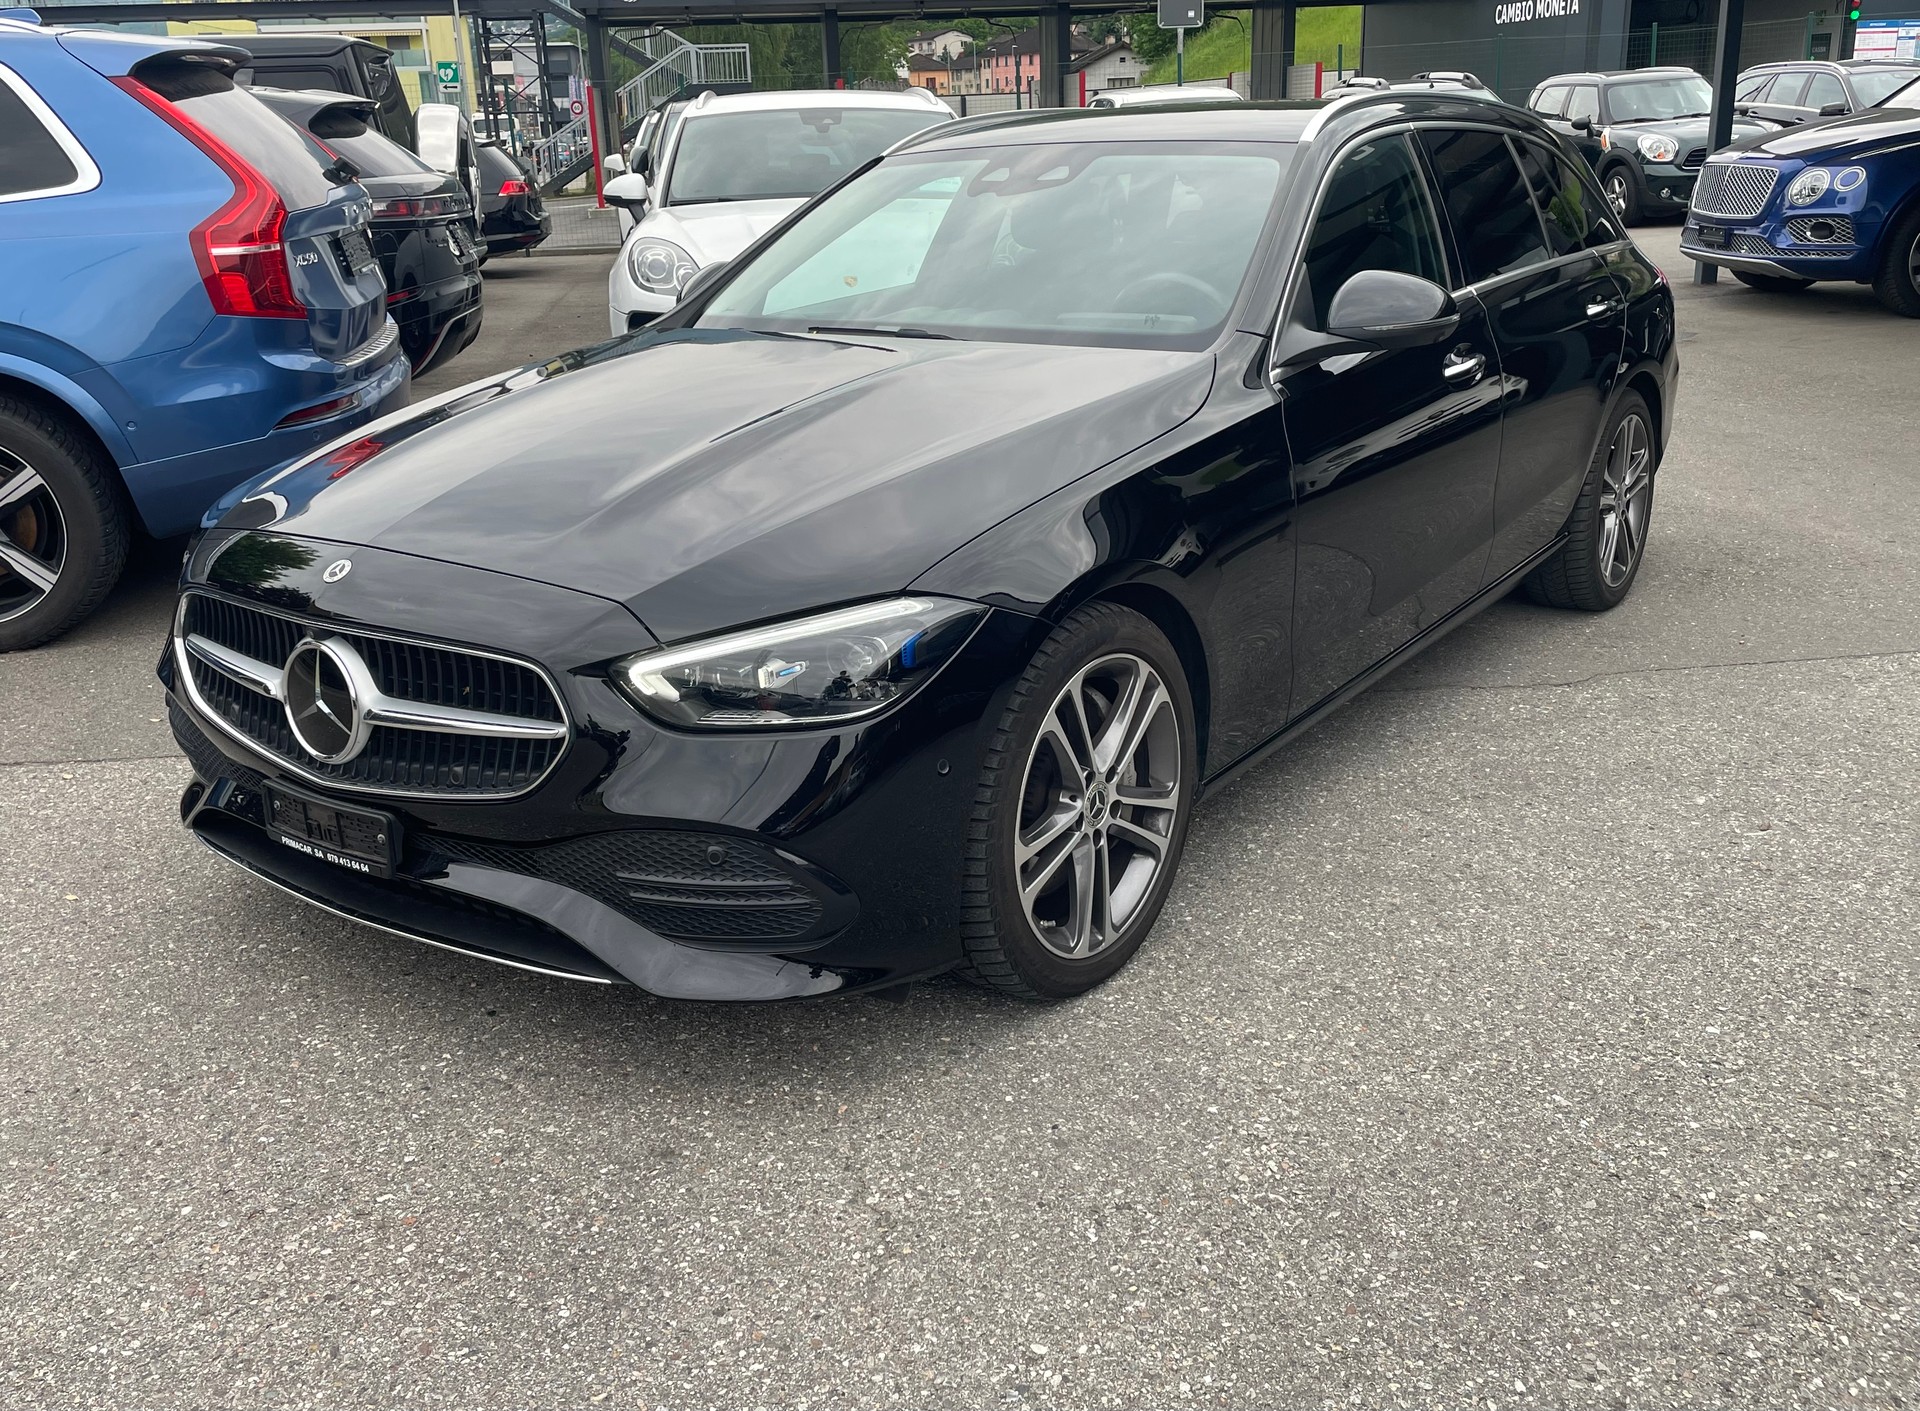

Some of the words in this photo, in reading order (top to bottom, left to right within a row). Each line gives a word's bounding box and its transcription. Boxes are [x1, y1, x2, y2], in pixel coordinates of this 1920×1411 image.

[1495, 0, 1533, 24] CAMBIO
[1535, 0, 1579, 19] MONETA
[293, 251, 318, 267] XC90
[281, 835, 313, 855] PRIMACAR
[313, 848, 324, 859] SA
[326, 852, 338, 864] 079
[339, 857, 351, 868] 413
[351, 860, 360, 870] 64
[360, 863, 370, 873] 64
